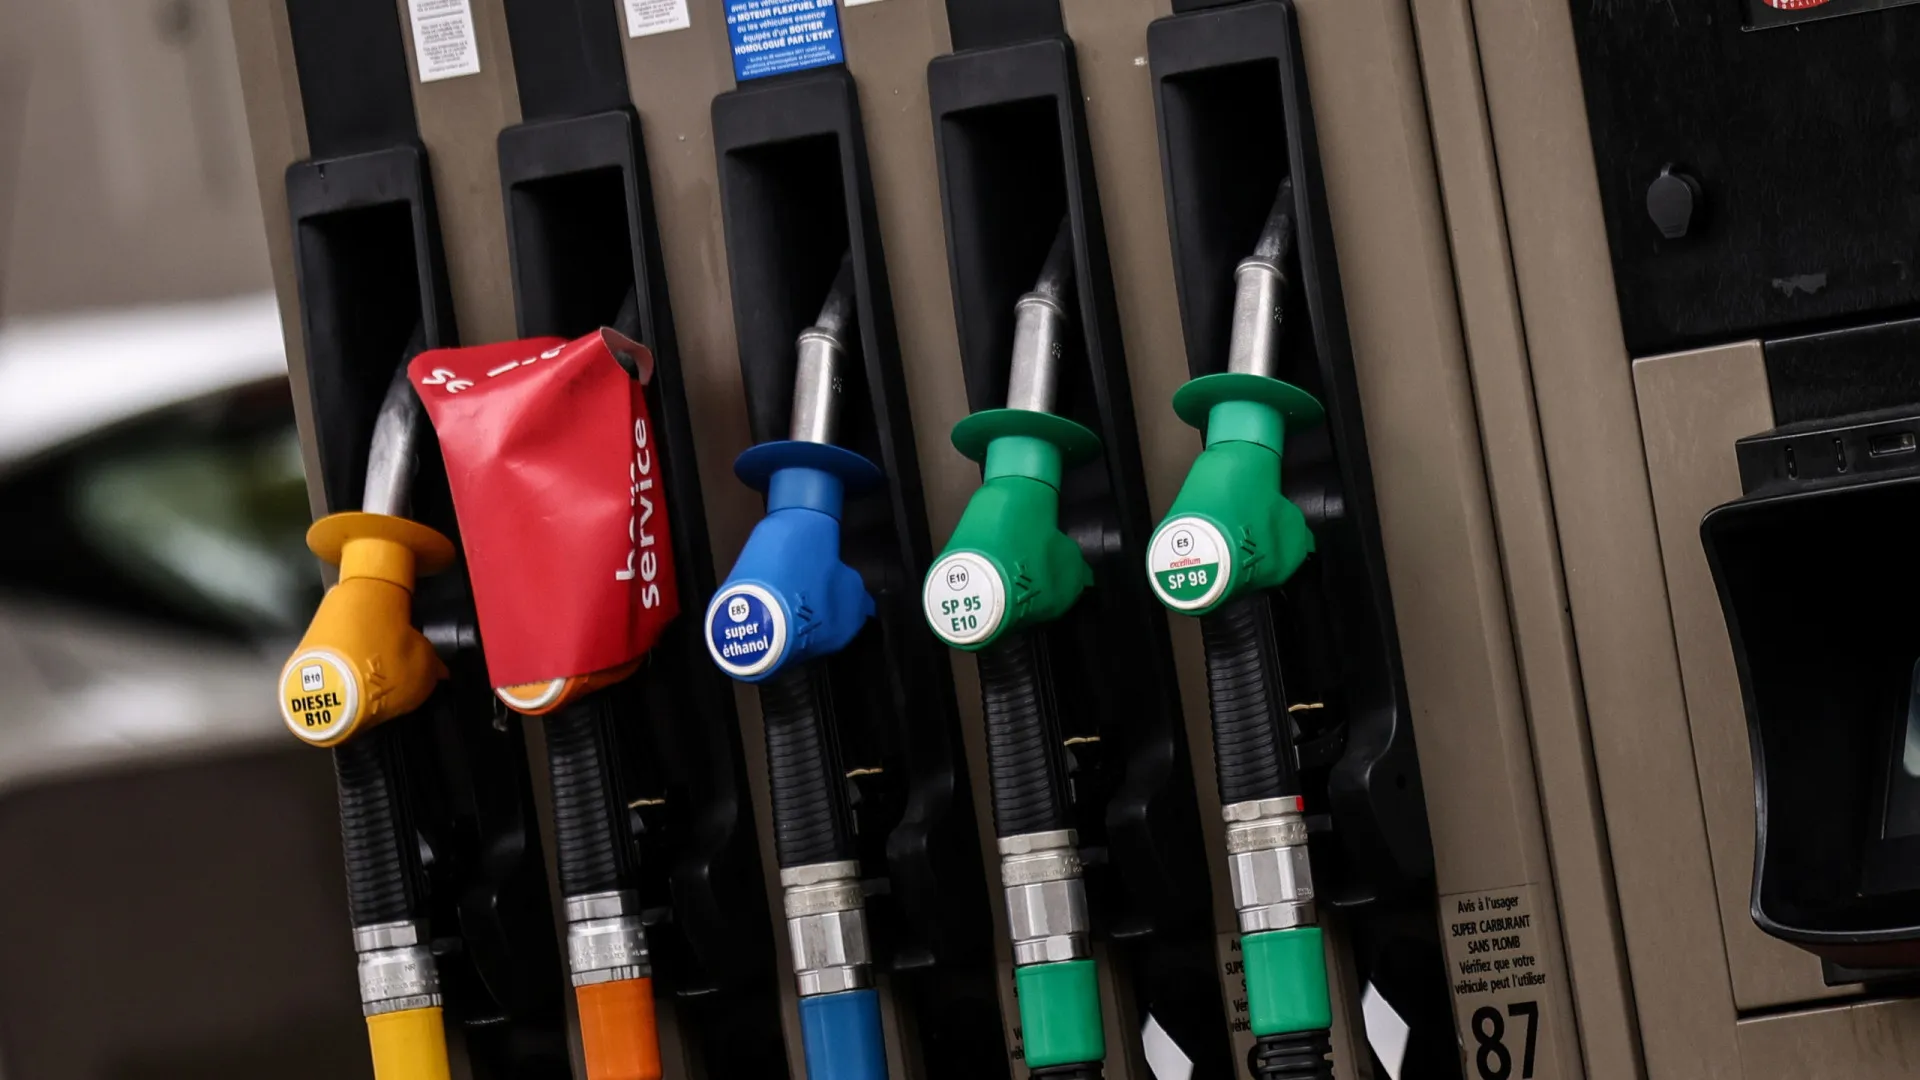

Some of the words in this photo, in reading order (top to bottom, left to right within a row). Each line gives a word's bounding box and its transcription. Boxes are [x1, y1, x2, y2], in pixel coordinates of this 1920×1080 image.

[737, 9, 771, 21] MOTEUR
[773, 1, 815, 15] FLEXFUEL
[787, 34, 806, 46] PAR
[635, 417, 660, 609] service
[1177, 538, 1189, 548] E5
[949, 573, 966, 584] E10
[1168, 573, 1186, 590] SP
[1188, 570, 1208, 586] 98
[731, 604, 747, 616] E85
[941, 599, 959, 615] SP
[963, 596, 981, 612] 95
[725, 623, 759, 640] super
[951, 615, 977, 632] E10
[723, 635, 769, 658] éthanol
[304, 673, 321, 684] B10
[291, 692, 341, 713] DIESEL
[305, 710, 331, 727] B10
[1457, 899, 1475, 914] Avis
[1478, 898, 1484, 911] à
[1486, 895, 1519, 911] l'usager
[1452, 921, 1477, 937] SUPER
[1480, 915, 1530, 933] CARBURANT
[1468, 939, 1490, 954] SANS
[1492, 935, 1520, 951] PLOMB
[1459, 958, 1491, 975] Vérifiez
[1494, 959, 1510, 973] que
[1512, 954, 1535, 969] votre
[1454, 978, 1489, 995] véhicule
[1490, 975, 1510, 993] peut
[1512, 971, 1546, 987] l'utiliser
[1471, 1001, 1539, 1080] 87
